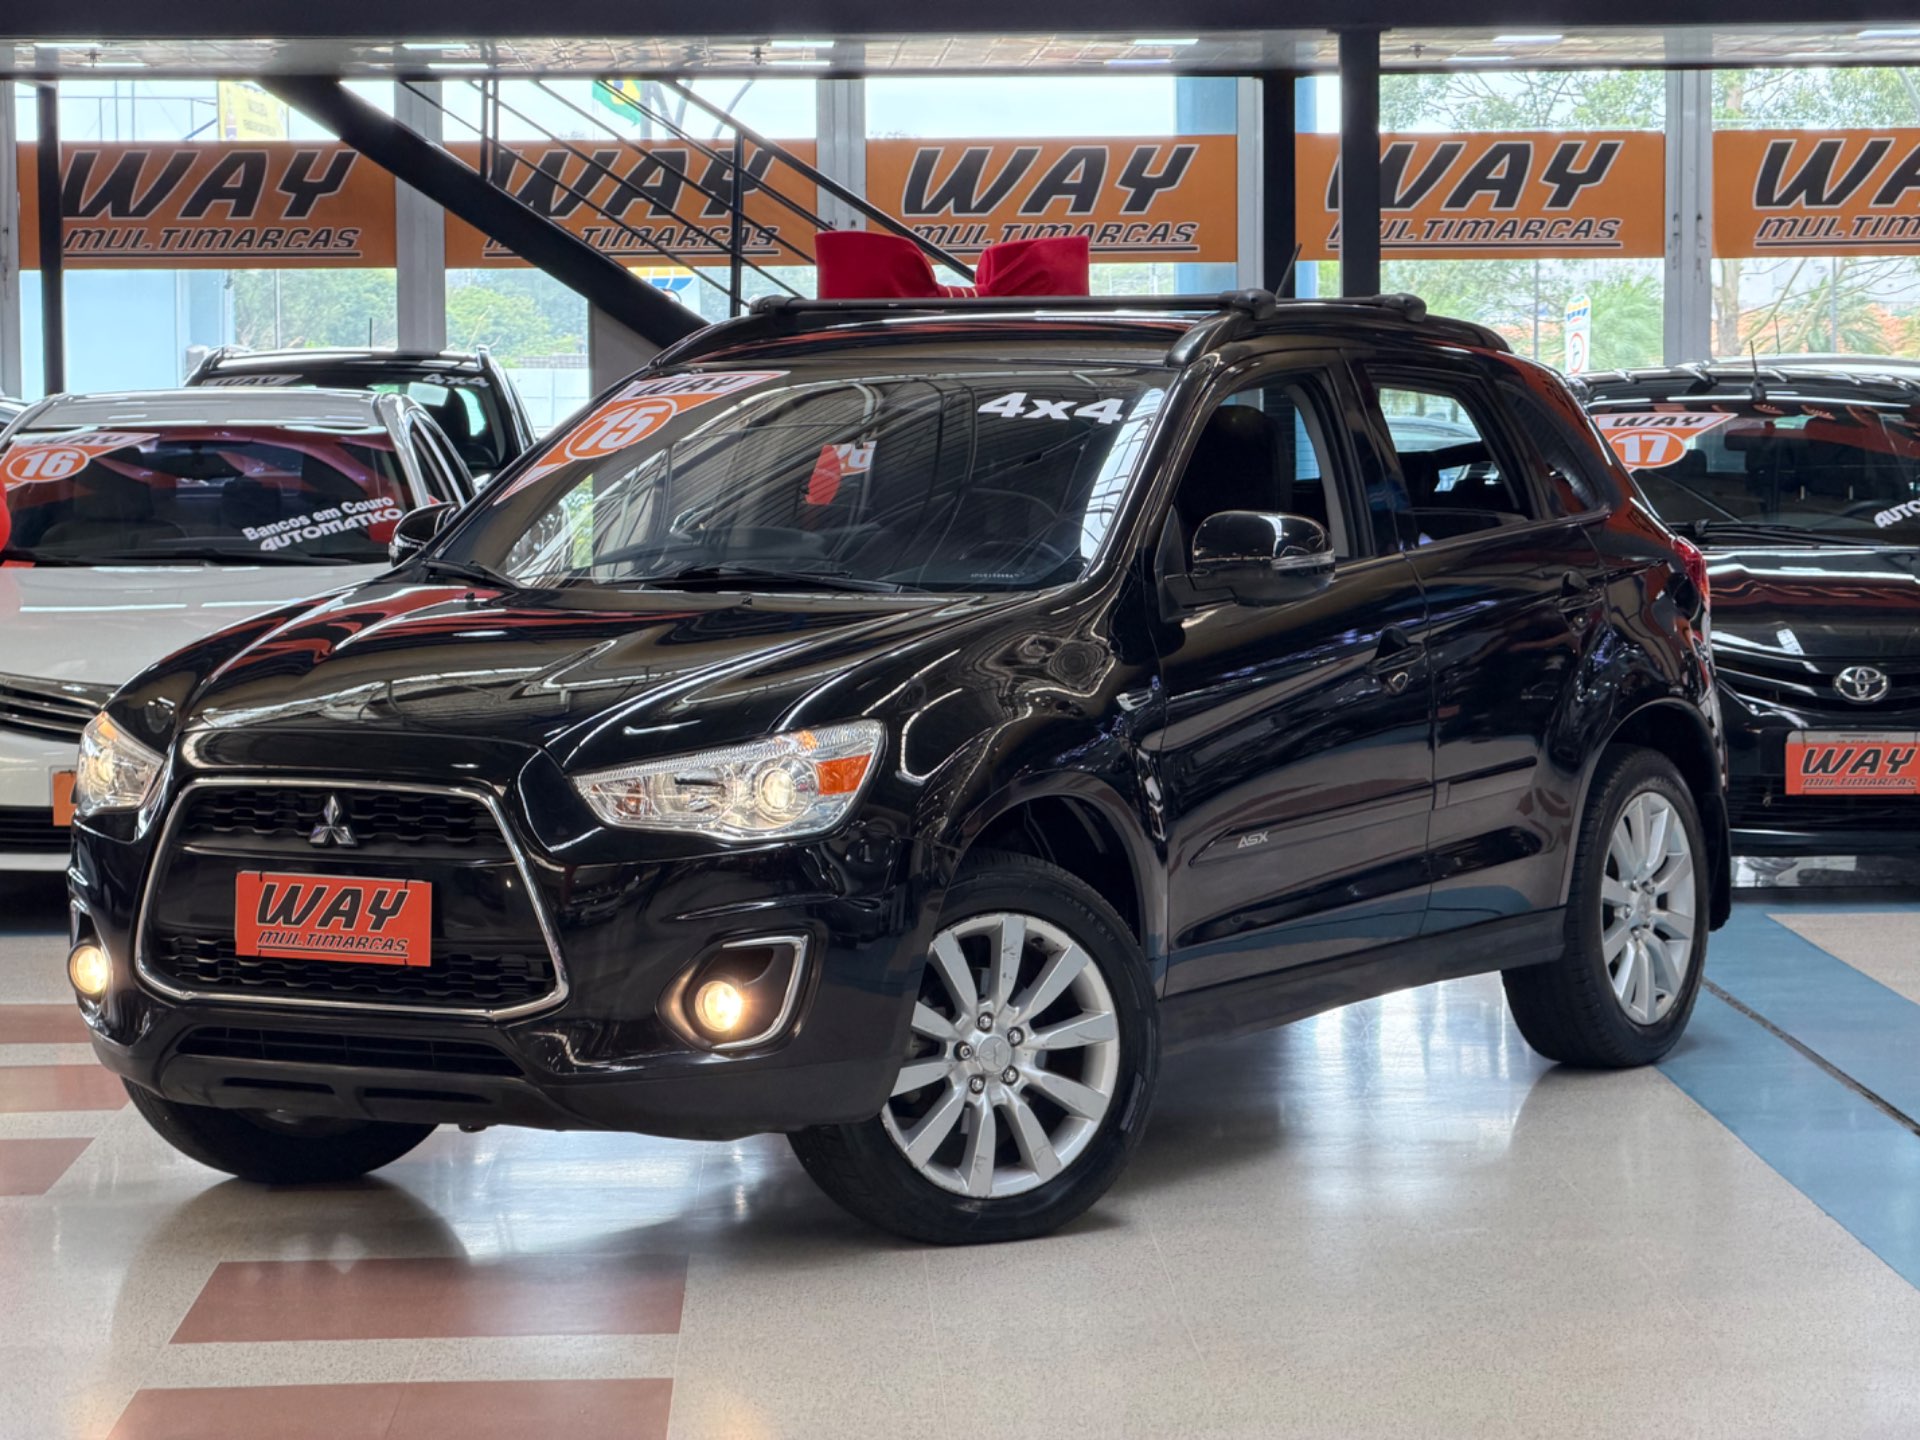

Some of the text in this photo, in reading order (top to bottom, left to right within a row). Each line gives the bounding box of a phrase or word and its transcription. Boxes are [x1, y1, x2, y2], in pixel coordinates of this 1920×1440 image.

[61, 150, 358, 220] WAY
[487, 149, 776, 219] WAY
[902, 144, 1200, 217] WAY
[1325, 141, 1624, 212] WAY
[62, 226, 361, 249] MULTIMARCAS
[1327, 218, 1623, 241] ULTIMARCAS
[422, 373, 490, 388] 4x4
[631, 376, 743, 398] WAY
[977, 392, 1125, 425] 4x4
[1612, 416, 1704, 427] WAY
[575, 405, 669, 452] 15
[1615, 434, 1669, 463] 17
[21, 451, 79, 478] 16
[241, 496, 395, 542] Bancos em Couro
[1801, 746, 1918, 776] WAY
[1803, 776, 1918, 787] MULTIMARCAS
[1237, 830, 1269, 849] ASX
[256, 881, 411, 932] WAY
[258, 930, 409, 952] MULTIMARCAS
